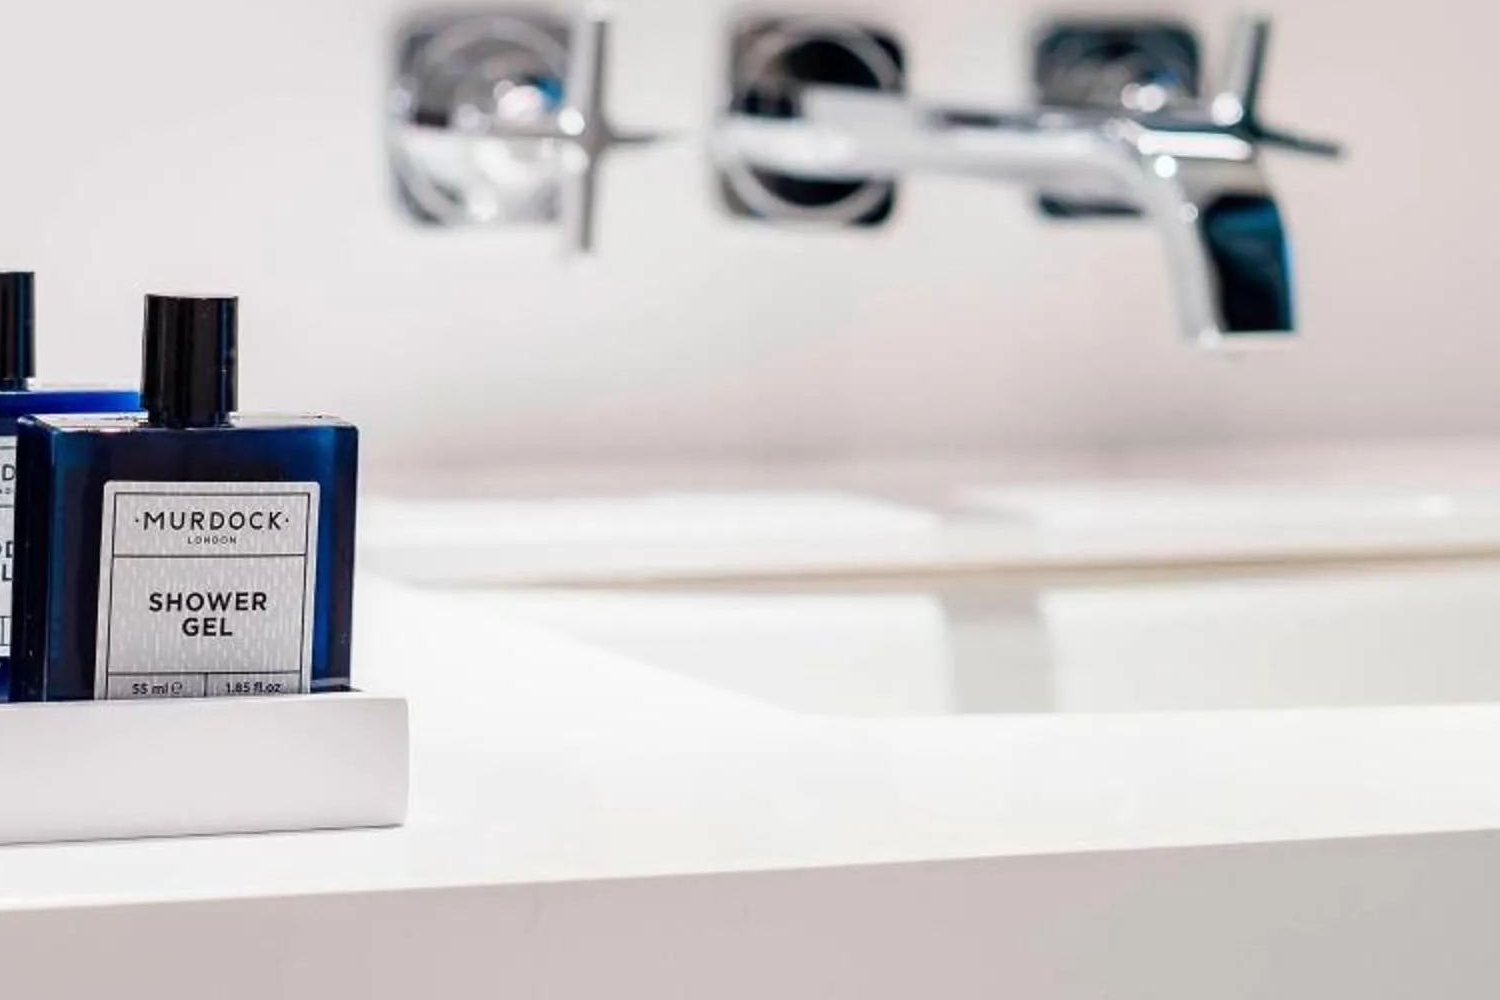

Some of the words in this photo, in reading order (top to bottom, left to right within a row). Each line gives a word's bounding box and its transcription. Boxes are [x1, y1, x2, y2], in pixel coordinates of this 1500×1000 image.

[187, 536, 237, 545] LONDON
[149, 592, 268, 612] SHOWER
[181, 618, 233, 637] GEL
[131, 683, 149, 695] 55
[152, 682, 169, 695] ml
[226, 682, 251, 693] 1.85
